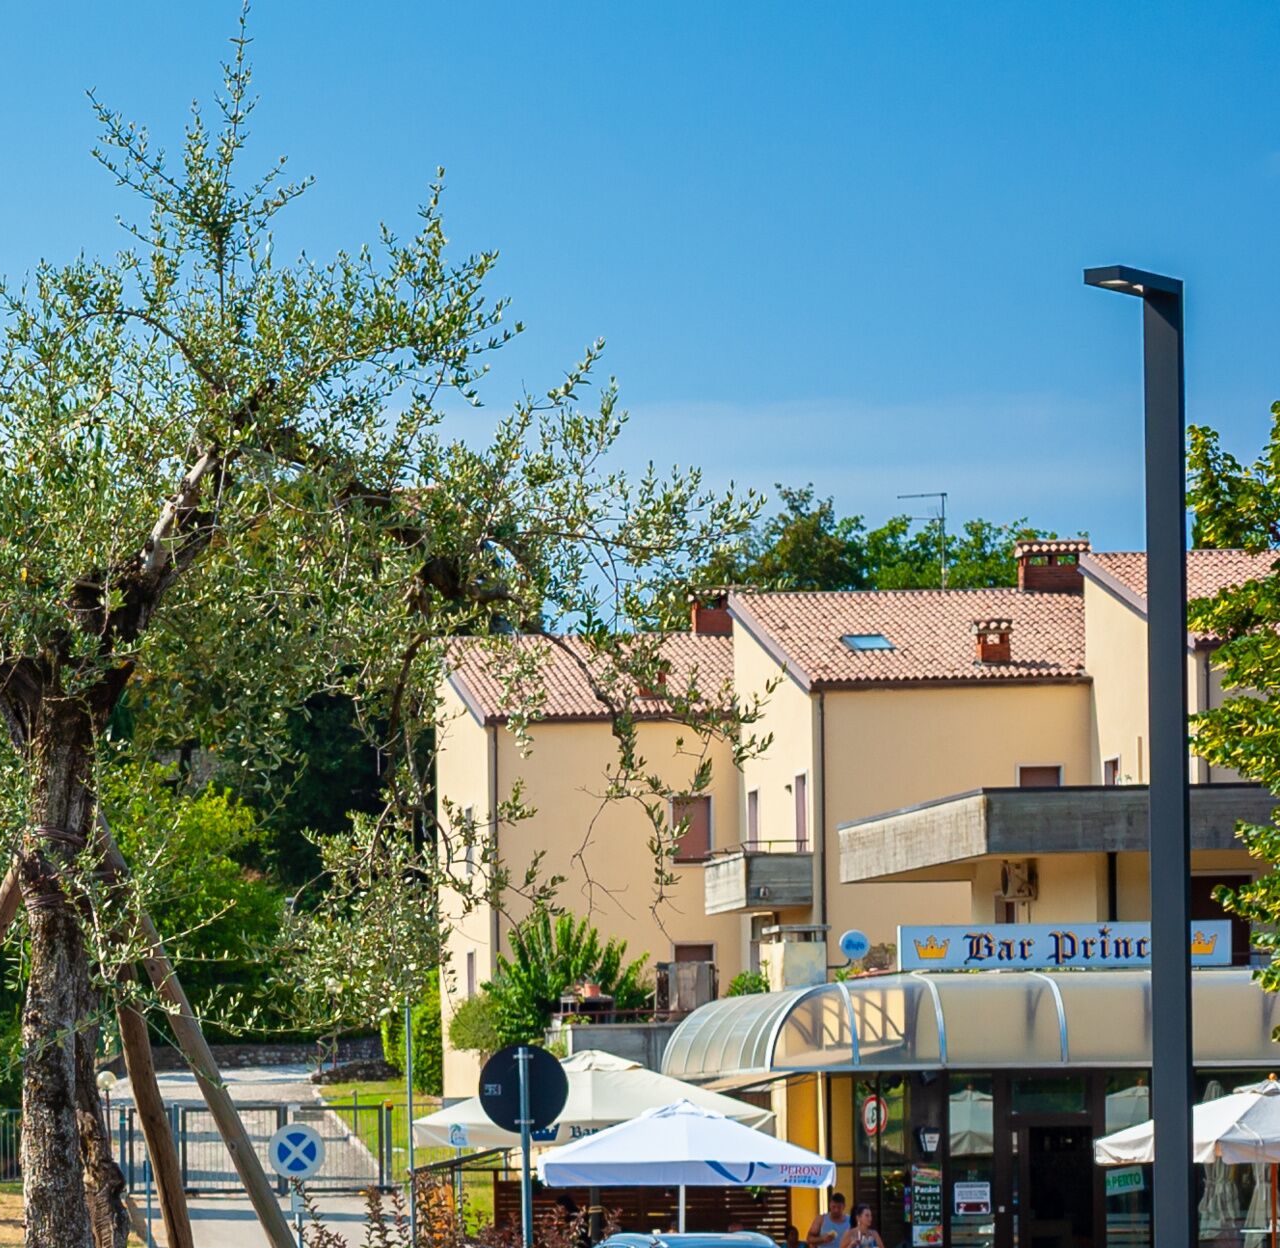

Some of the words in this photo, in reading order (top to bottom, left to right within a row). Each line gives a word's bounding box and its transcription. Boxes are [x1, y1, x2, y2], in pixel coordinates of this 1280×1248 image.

[962, 931, 1035, 965] Bar
[1046, 924, 1150, 965] Princ
[780, 1164, 822, 1176] PERONI
